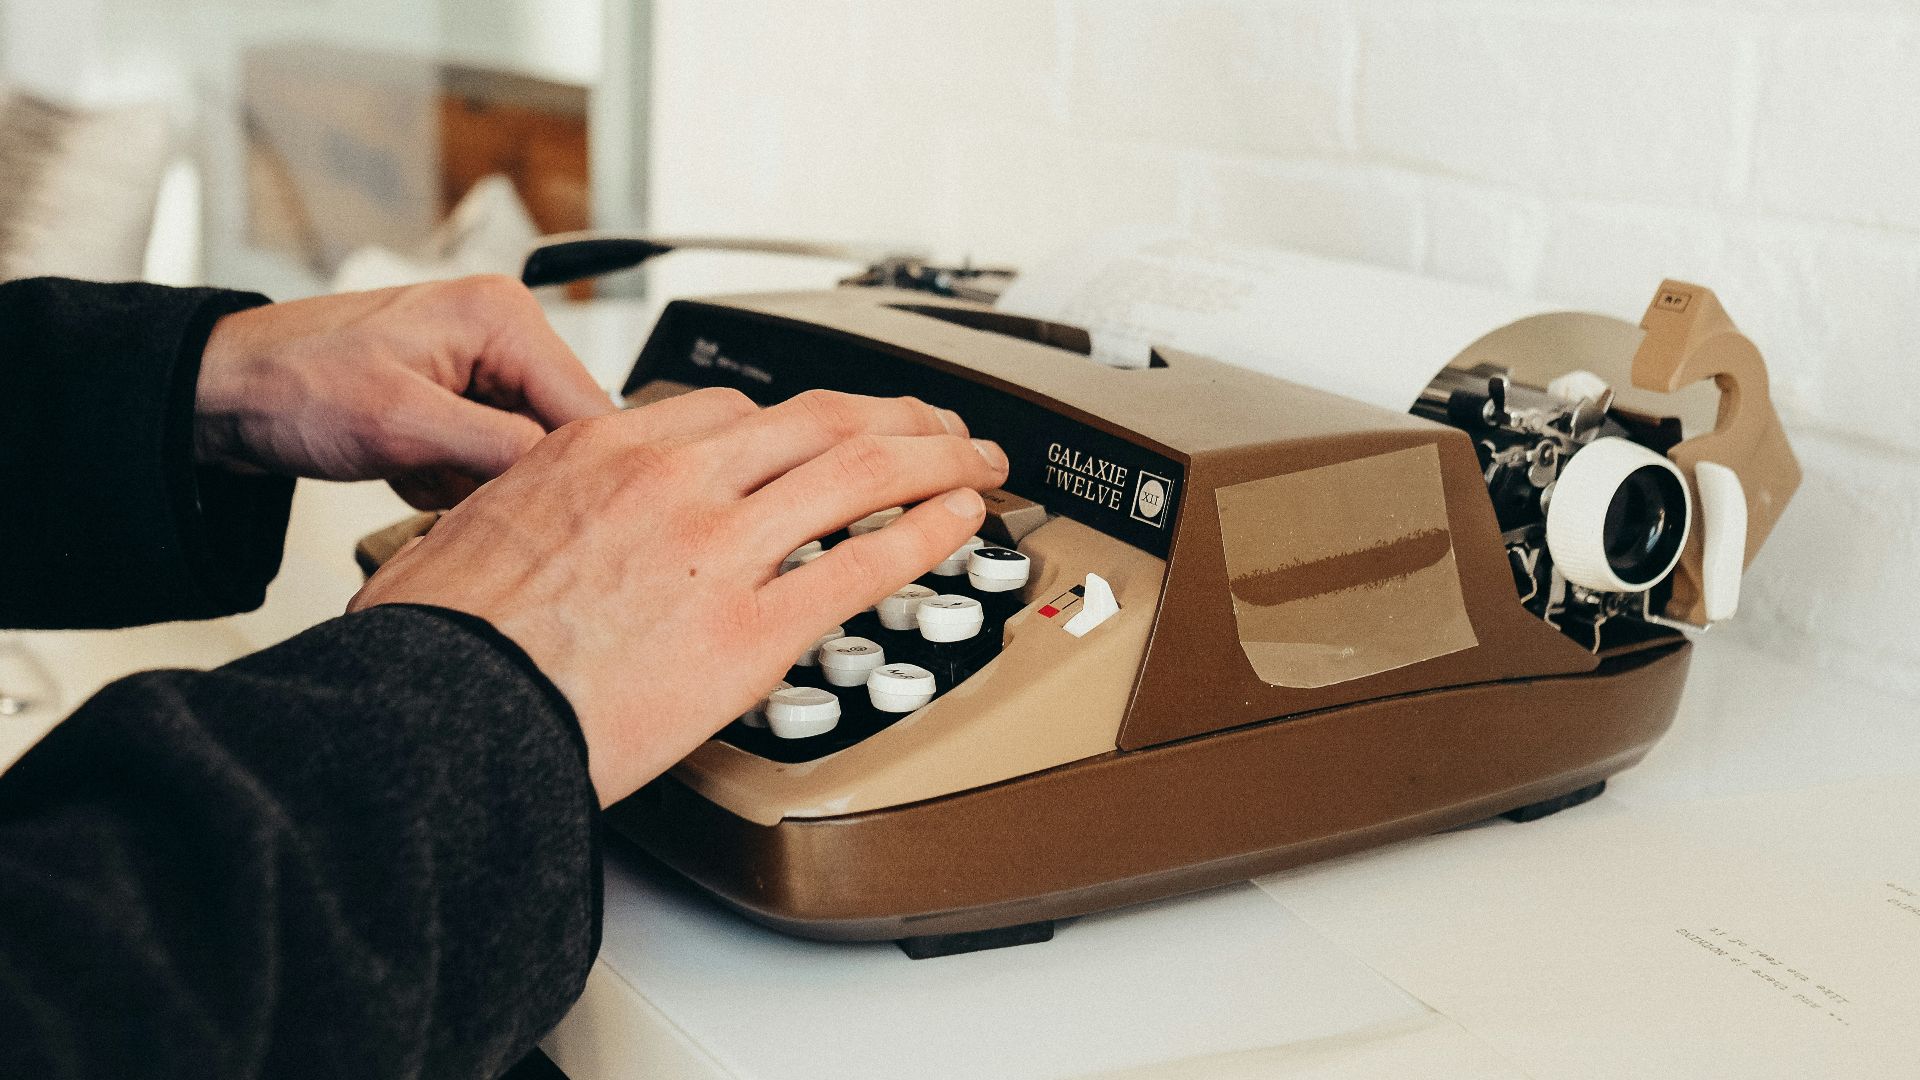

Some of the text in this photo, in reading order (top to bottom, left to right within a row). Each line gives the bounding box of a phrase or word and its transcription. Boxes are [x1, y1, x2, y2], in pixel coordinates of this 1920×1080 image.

[1048, 443, 1128, 487] GALAXIE
[1045, 465, 1123, 511] TWELVE
[1141, 491, 1160, 507] XII
[1675, 928, 1729, 957] NOTHING
[1709, 927, 1850, 1004] like the feel of it
[1730, 956, 1750, 967] is
[1752, 968, 1789, 991] there
